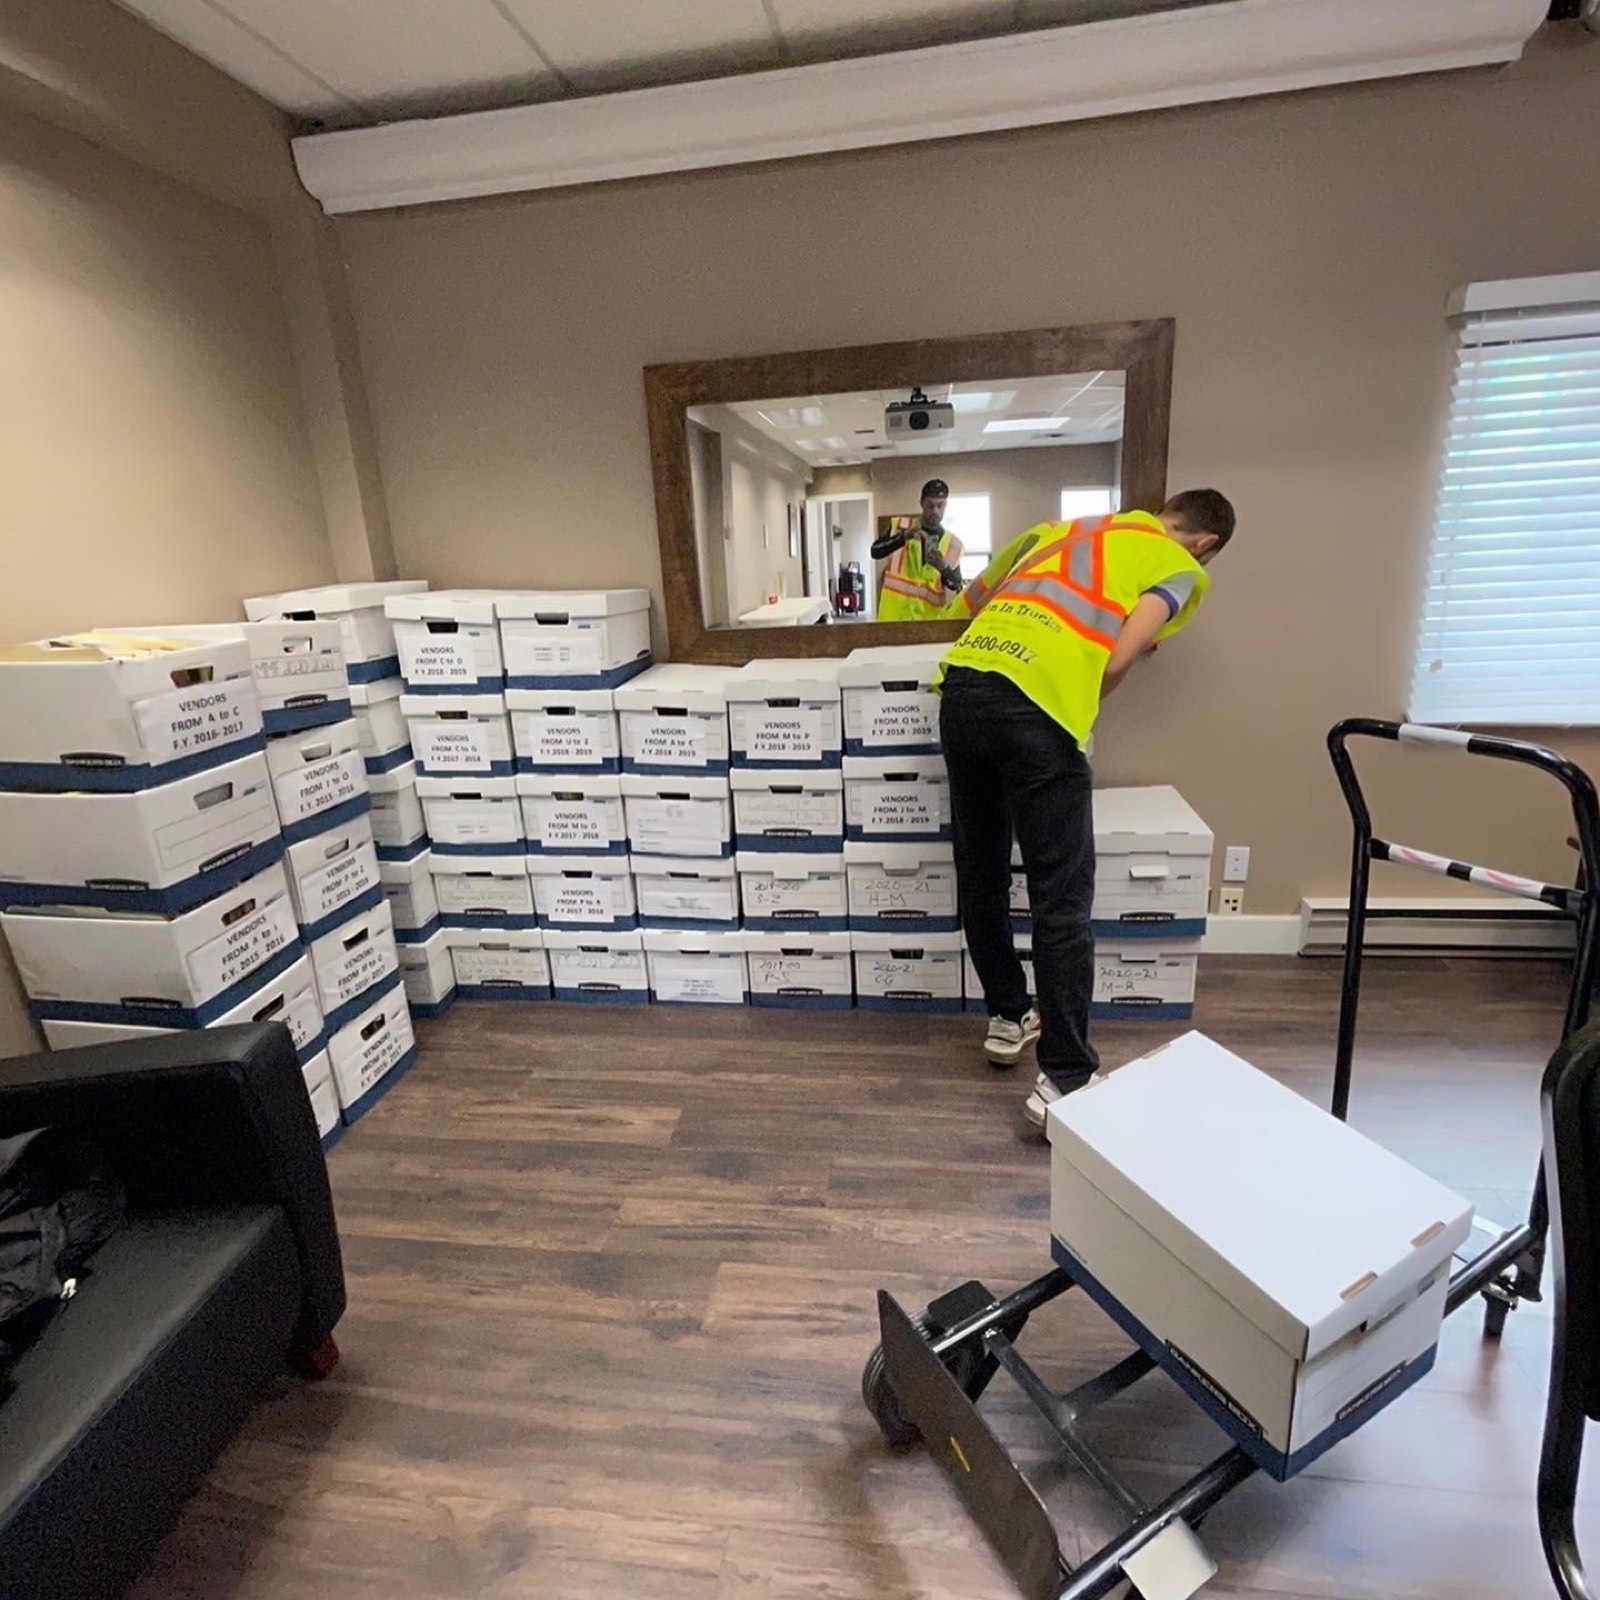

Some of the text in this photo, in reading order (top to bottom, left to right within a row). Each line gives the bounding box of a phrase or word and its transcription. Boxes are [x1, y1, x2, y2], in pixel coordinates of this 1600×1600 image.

[1000, 602, 1013, 613] In
[178, 693, 227, 712] VENDORS
[881, 705, 920, 714] VENDORS
[171, 706, 240, 733] FROM A to C
[764, 721, 801, 729] VENDORS
[874, 717, 898, 725] FROM
[223, 721, 244, 737] 2017
[651, 728, 687, 736] VENDORS
[756, 732, 779, 740] FROM
[783, 732, 791, 740] M
[792, 732, 801, 740] to
[912, 727, 932, 735] 2019
[303, 761, 340, 781] VENDORS
[300, 781, 323, 798] FROM
[880, 795, 919, 803] VENDORS
[326, 856, 356, 879] VENDORS
[322, 879, 342, 895] FROM
[869, 892, 907, 907] H-M
[226, 915, 268, 946] VENDORS
[221, 942, 250, 966] FROM
[261, 929, 272, 940] to
[338, 969, 359, 987] FROM
[1100, 967, 1158, 979] 2020-21
[1101, 981, 1135, 993] M-R
